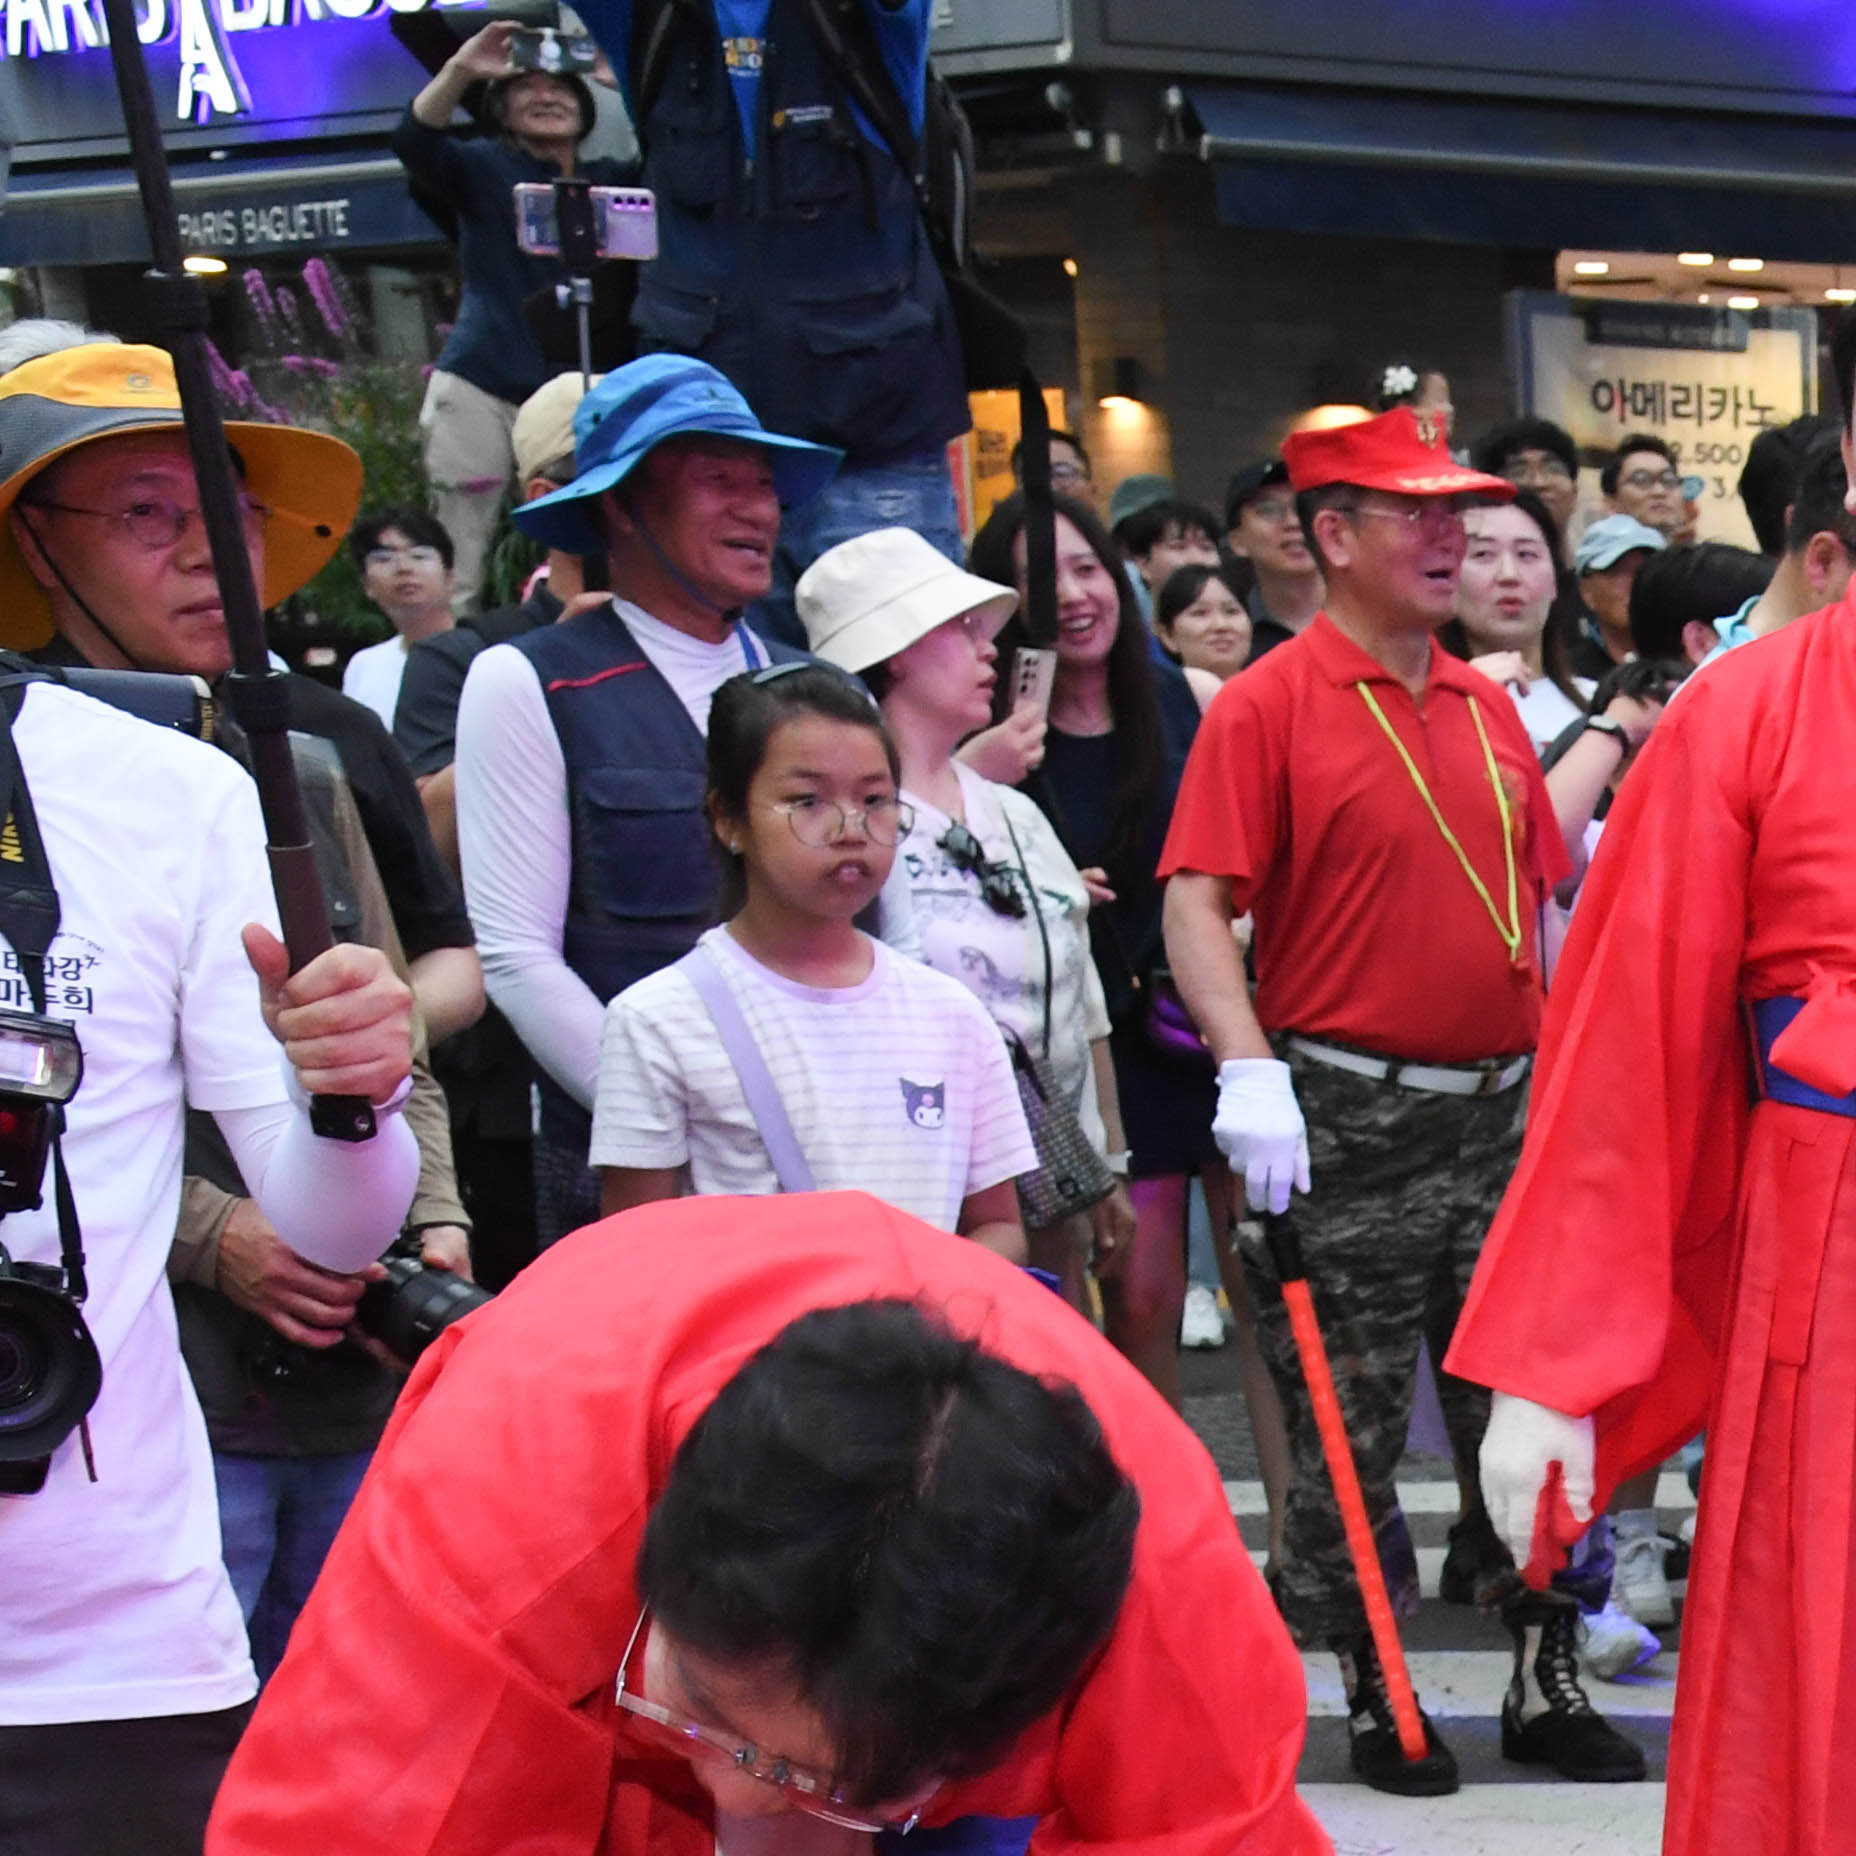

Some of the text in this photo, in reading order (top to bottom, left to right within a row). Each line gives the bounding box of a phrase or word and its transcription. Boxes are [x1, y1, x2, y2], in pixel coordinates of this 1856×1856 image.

[177, 199, 350, 246] PARIS BAGUETTE
[1591, 377, 1776, 428] 아메리카노
